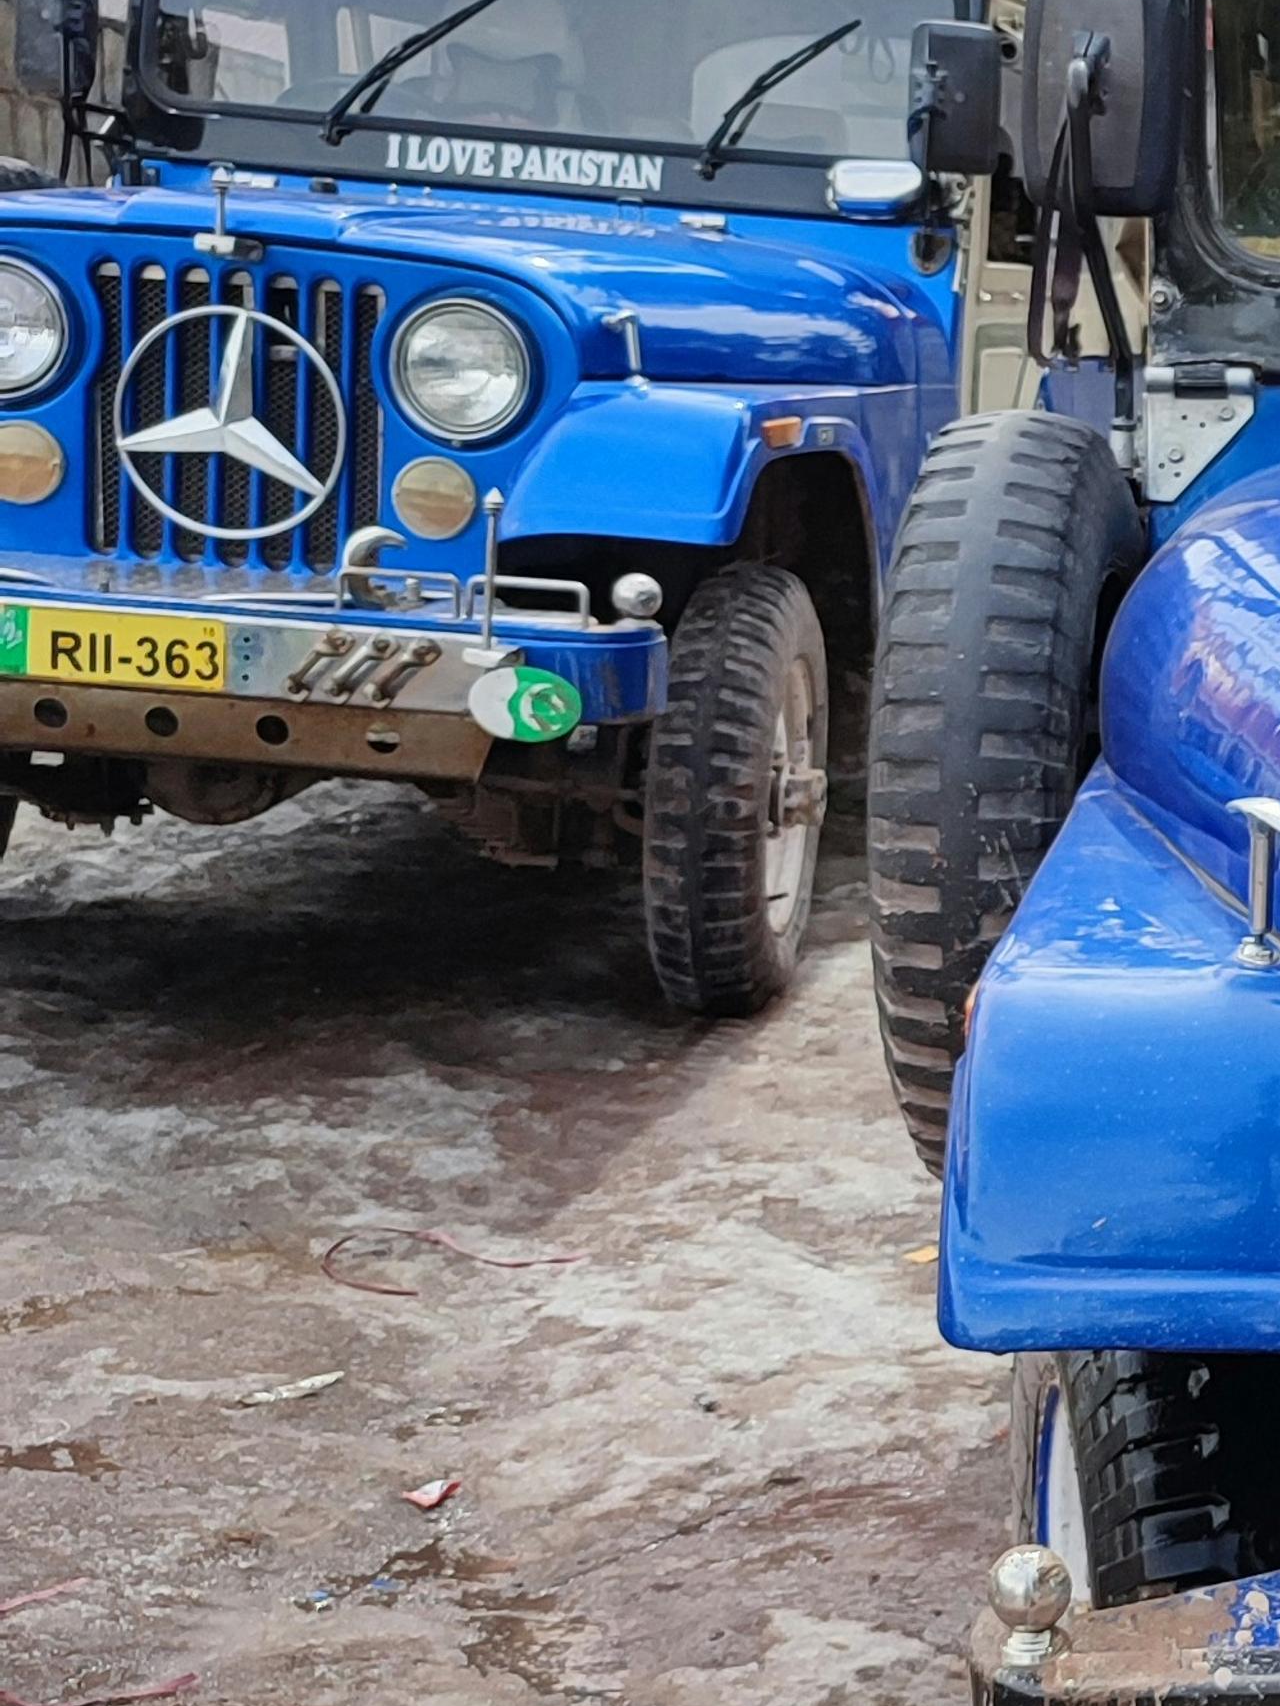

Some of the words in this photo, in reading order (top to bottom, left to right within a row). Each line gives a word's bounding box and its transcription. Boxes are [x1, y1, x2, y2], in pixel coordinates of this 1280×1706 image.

[385, 134, 402, 168] I
[405, 134, 495, 176] LOVE
[499, 142, 664, 191] PAKISTAN
[50, 630, 220, 681] RII-363
